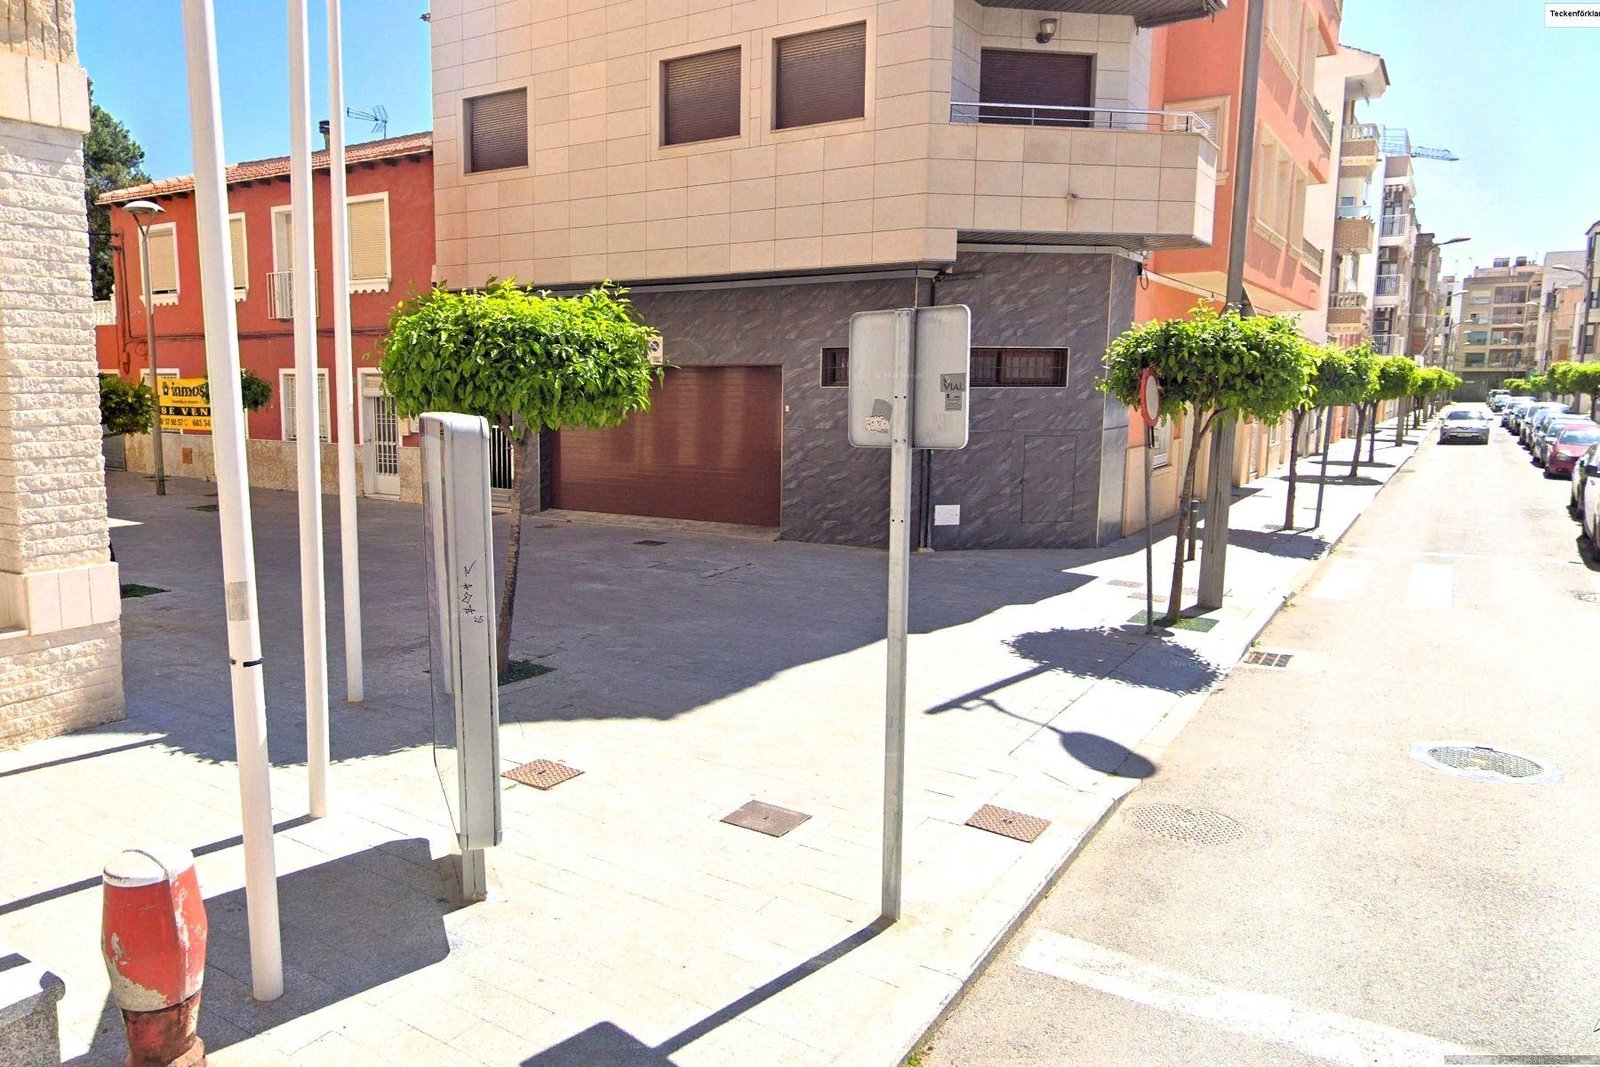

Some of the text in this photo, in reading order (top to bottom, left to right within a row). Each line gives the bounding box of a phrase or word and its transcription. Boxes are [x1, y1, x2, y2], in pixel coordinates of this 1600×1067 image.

[943, 382, 964, 391] VIAL
[161, 406, 209, 416] SE VEN
